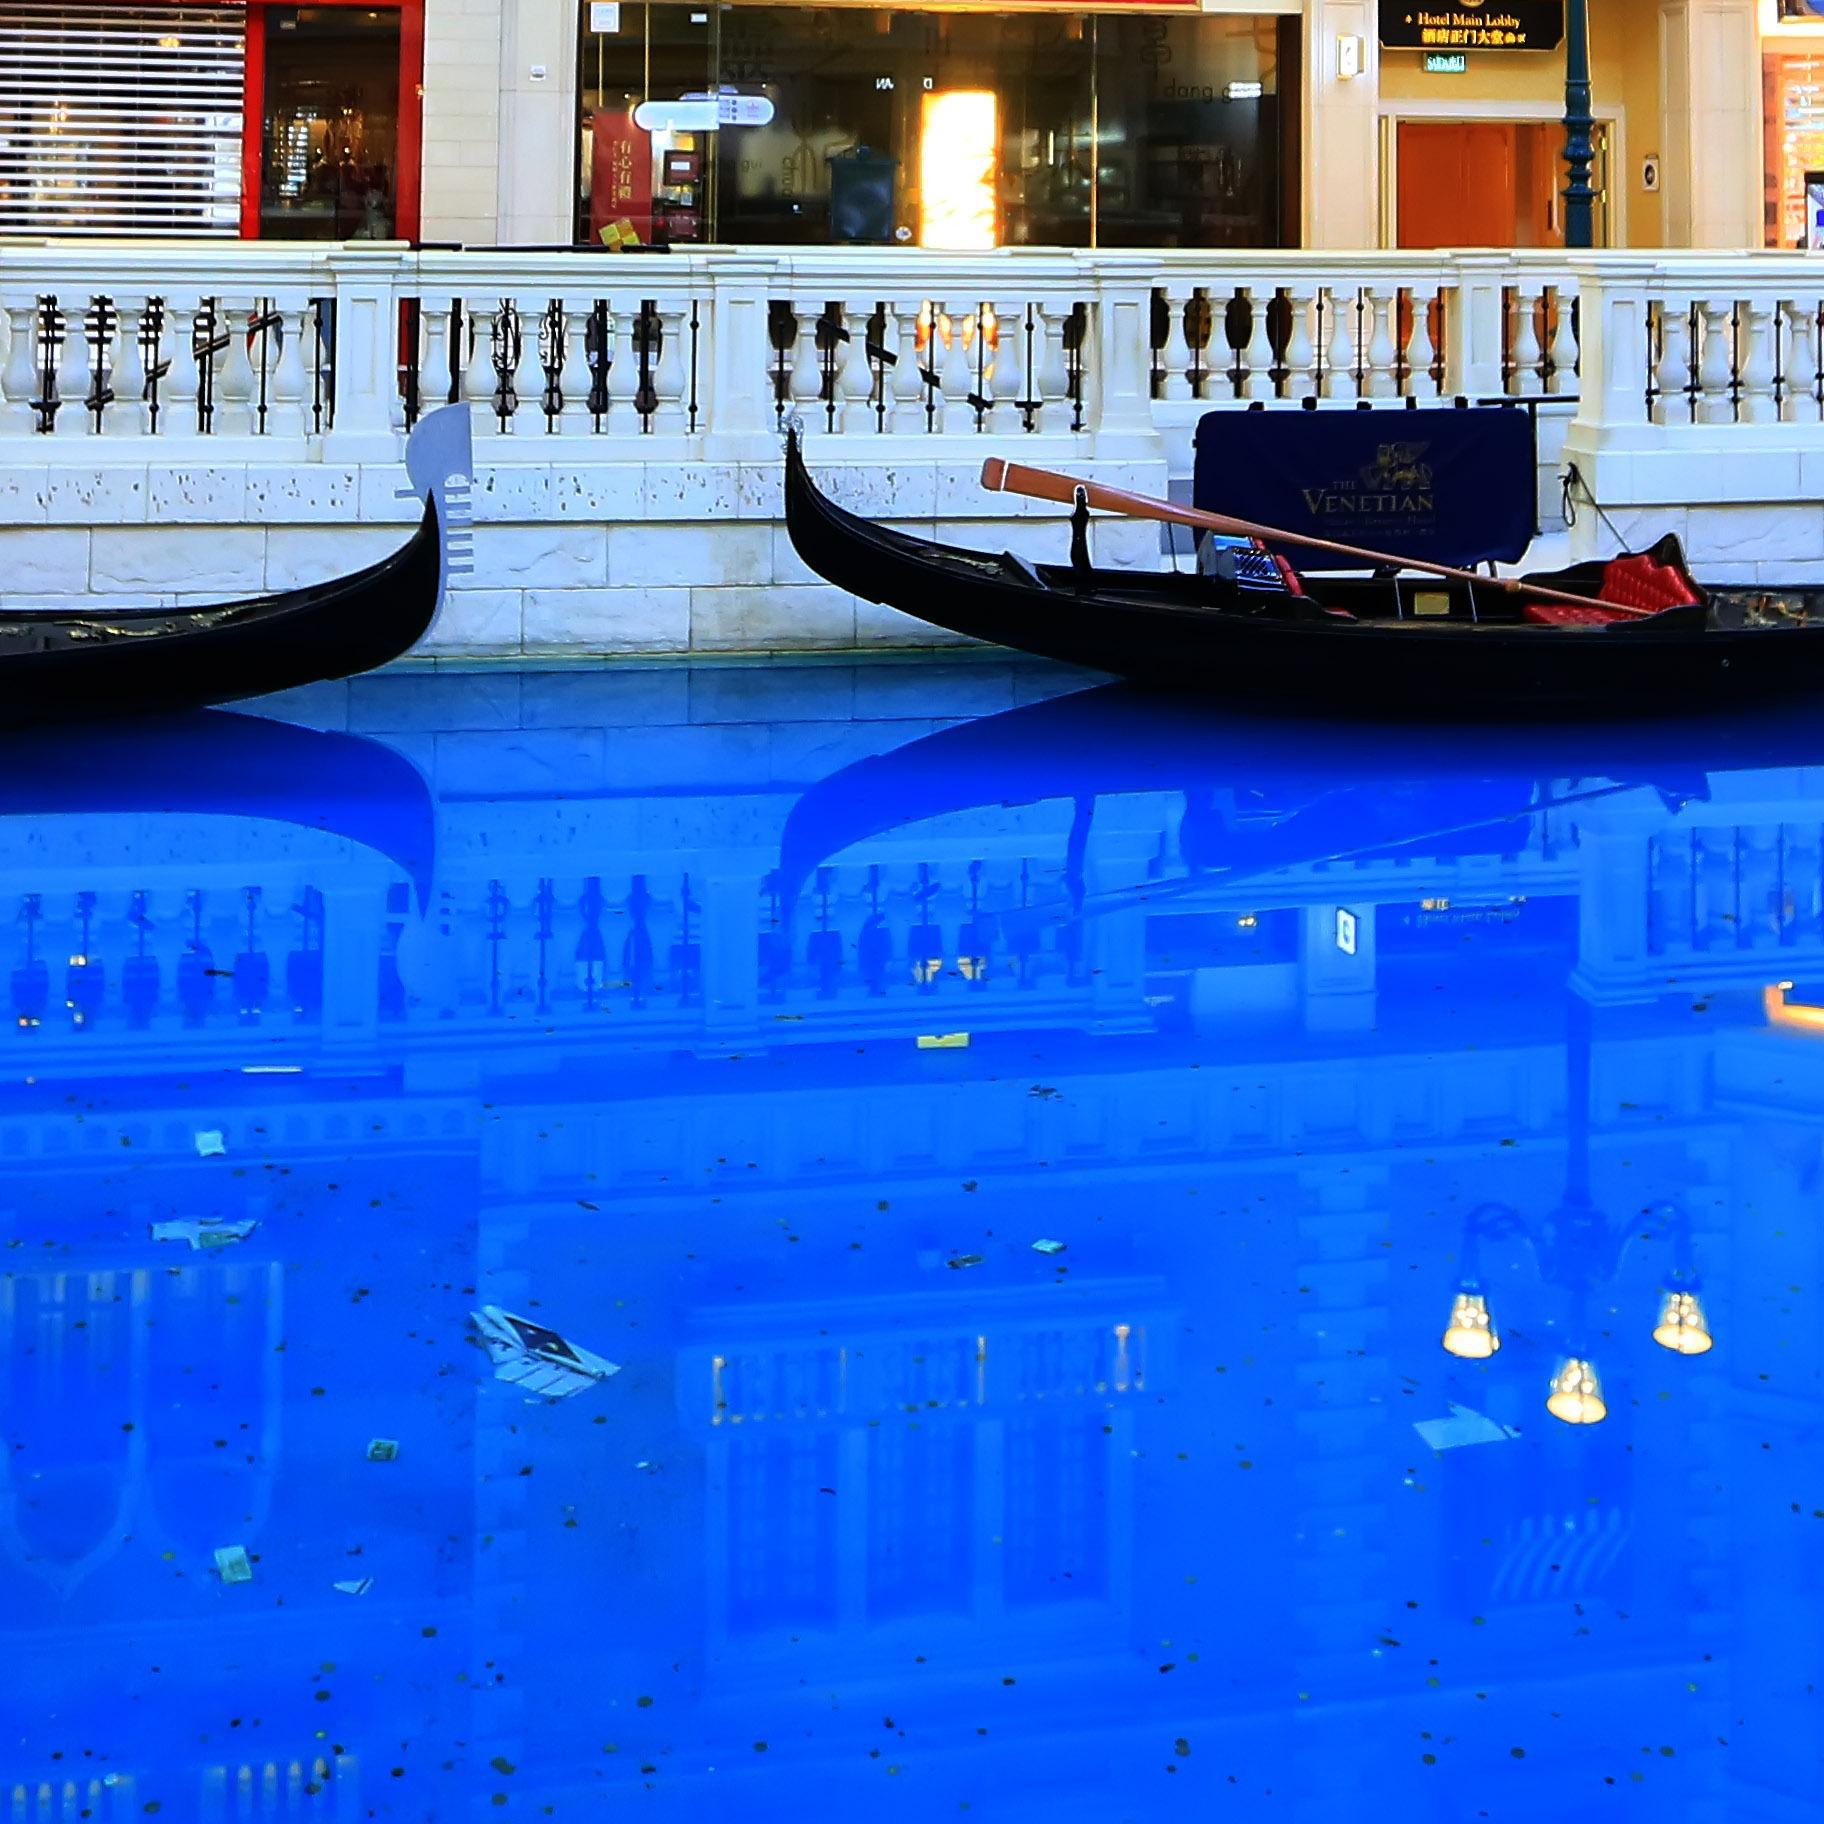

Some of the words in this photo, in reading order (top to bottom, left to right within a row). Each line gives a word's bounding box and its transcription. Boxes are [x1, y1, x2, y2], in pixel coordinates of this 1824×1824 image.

[1418, 12, 1450, 25] Hotel
[1452, 13, 1483, 26] Main
[1486, 14, 1521, 29] Lobby
[1422, 28, 1504, 45] 酒店正门大堂
[1301, 488, 1434, 515] VENETIAN
